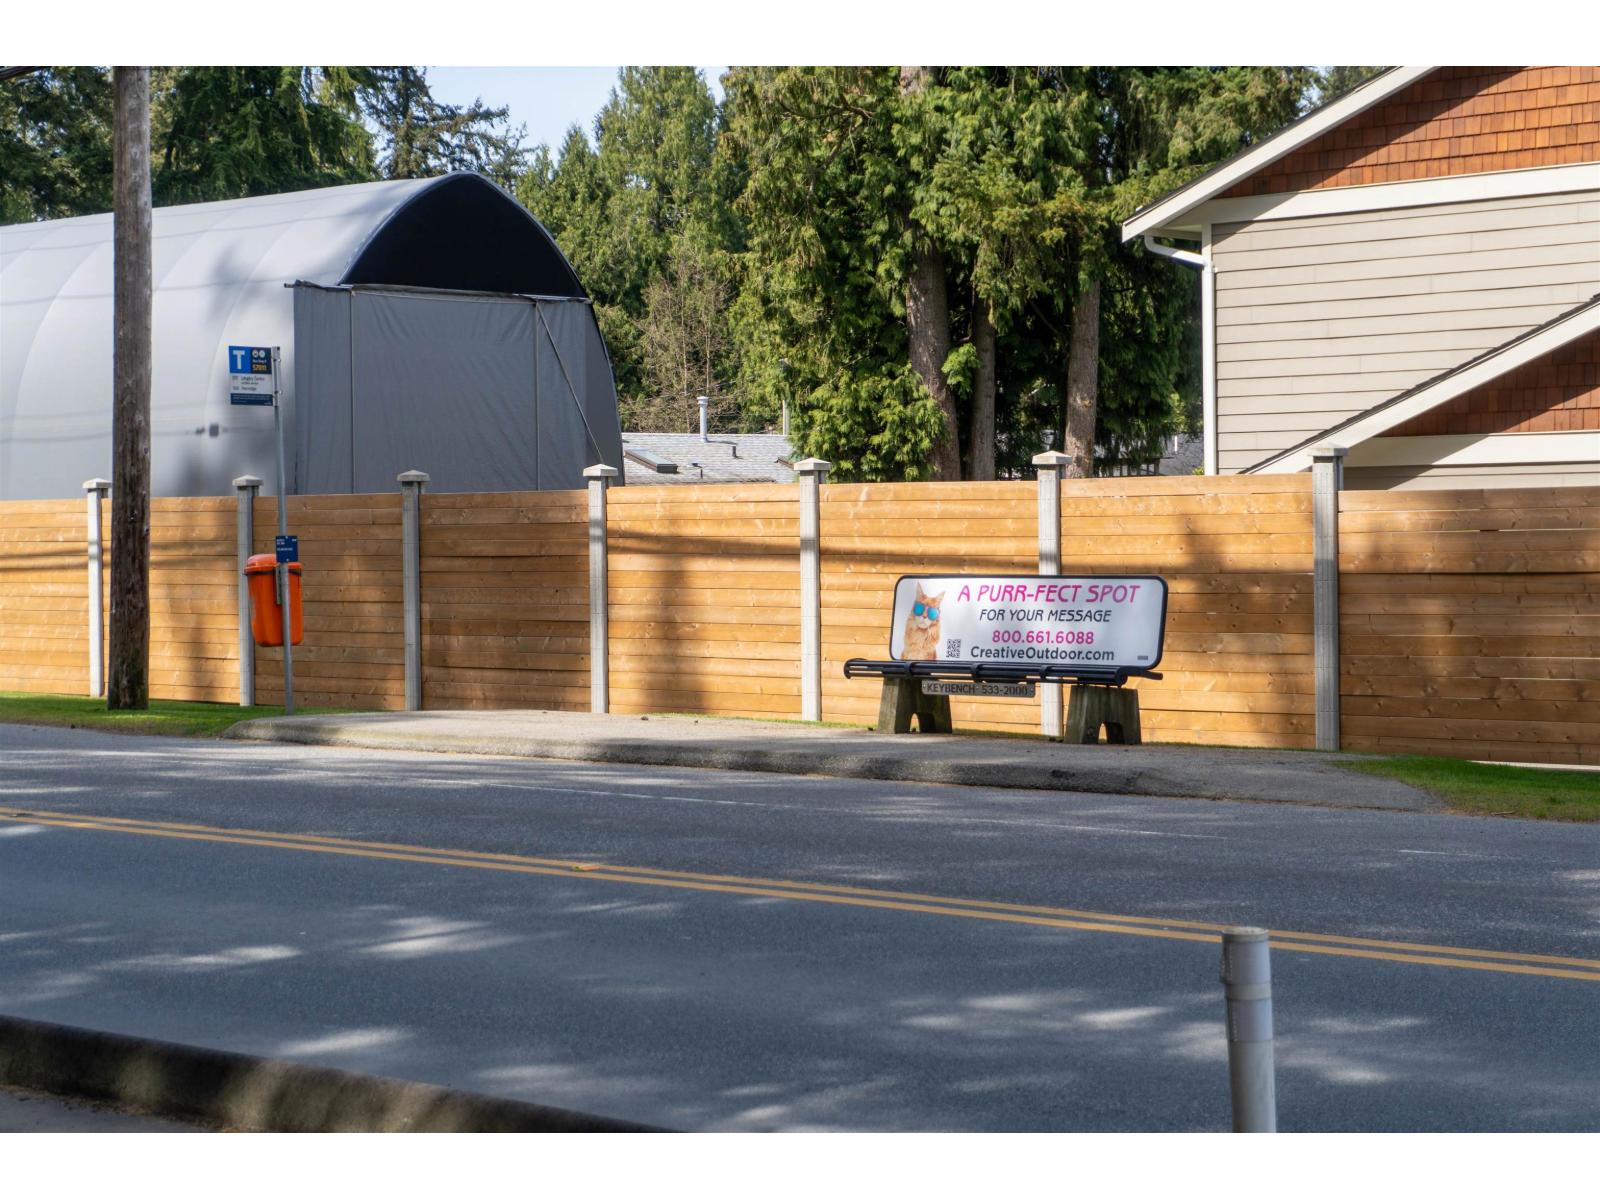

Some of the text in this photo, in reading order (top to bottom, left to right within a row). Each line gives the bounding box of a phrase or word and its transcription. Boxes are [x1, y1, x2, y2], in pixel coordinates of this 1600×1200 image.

[233, 350, 245, 369] T
[957, 585, 1140, 602] A PURR-FECT SPOT
[979, 609, 1112, 622] FOR YOUR MESSAGE
[992, 630, 1094, 645] 800.661.6088
[970, 645, 1115, 661] CreativeOutdoor.com
